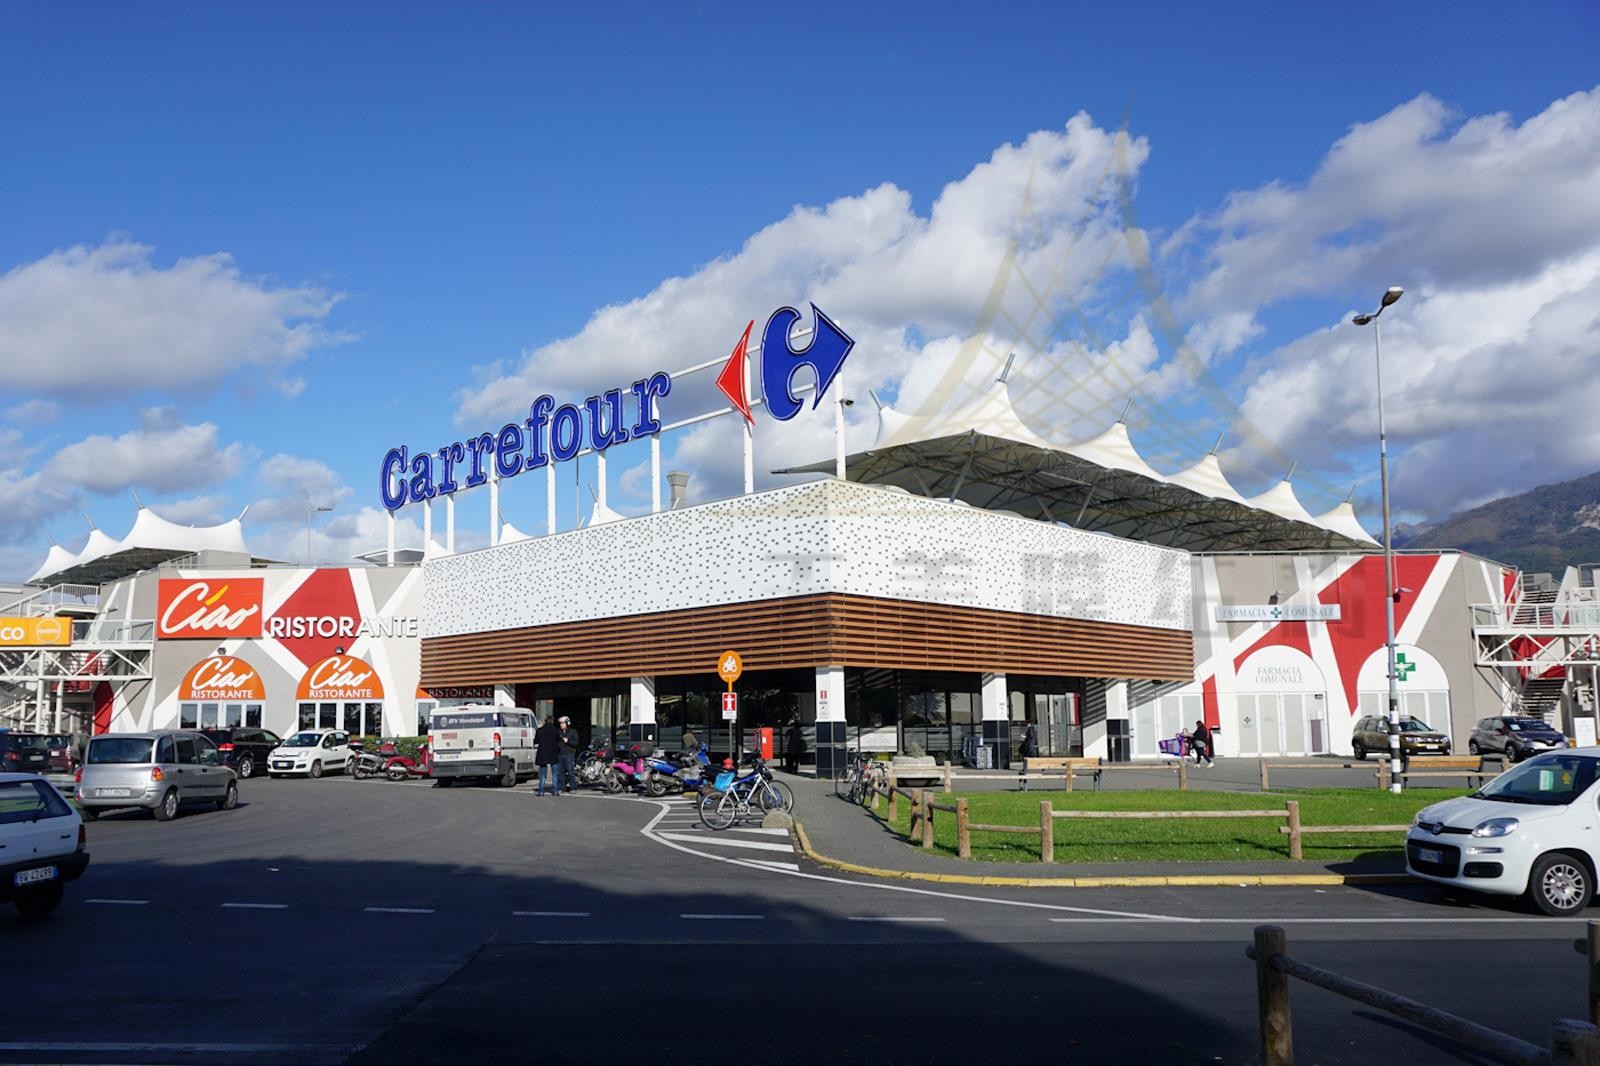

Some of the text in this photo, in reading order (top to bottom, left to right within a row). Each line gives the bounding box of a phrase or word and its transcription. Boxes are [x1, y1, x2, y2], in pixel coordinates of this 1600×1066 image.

[380, 371, 673, 512] Carrefour
[160, 581, 259, 634] Ciao
[1222, 608, 1335, 619] FARMACIA COMUNALE
[270, 615, 418, 639] RISTORANTE
[191, 656, 254, 690] Ciao
[309, 656, 372, 690] Ciao
[1257, 666, 1303, 675] FARMACIA
[1255, 675, 1305, 684] COMUNALE
[191, 689, 253, 699] RISTORANTE
[309, 688, 373, 699] RISTORANTE
[428, 687, 493, 698] RISTORANTE
